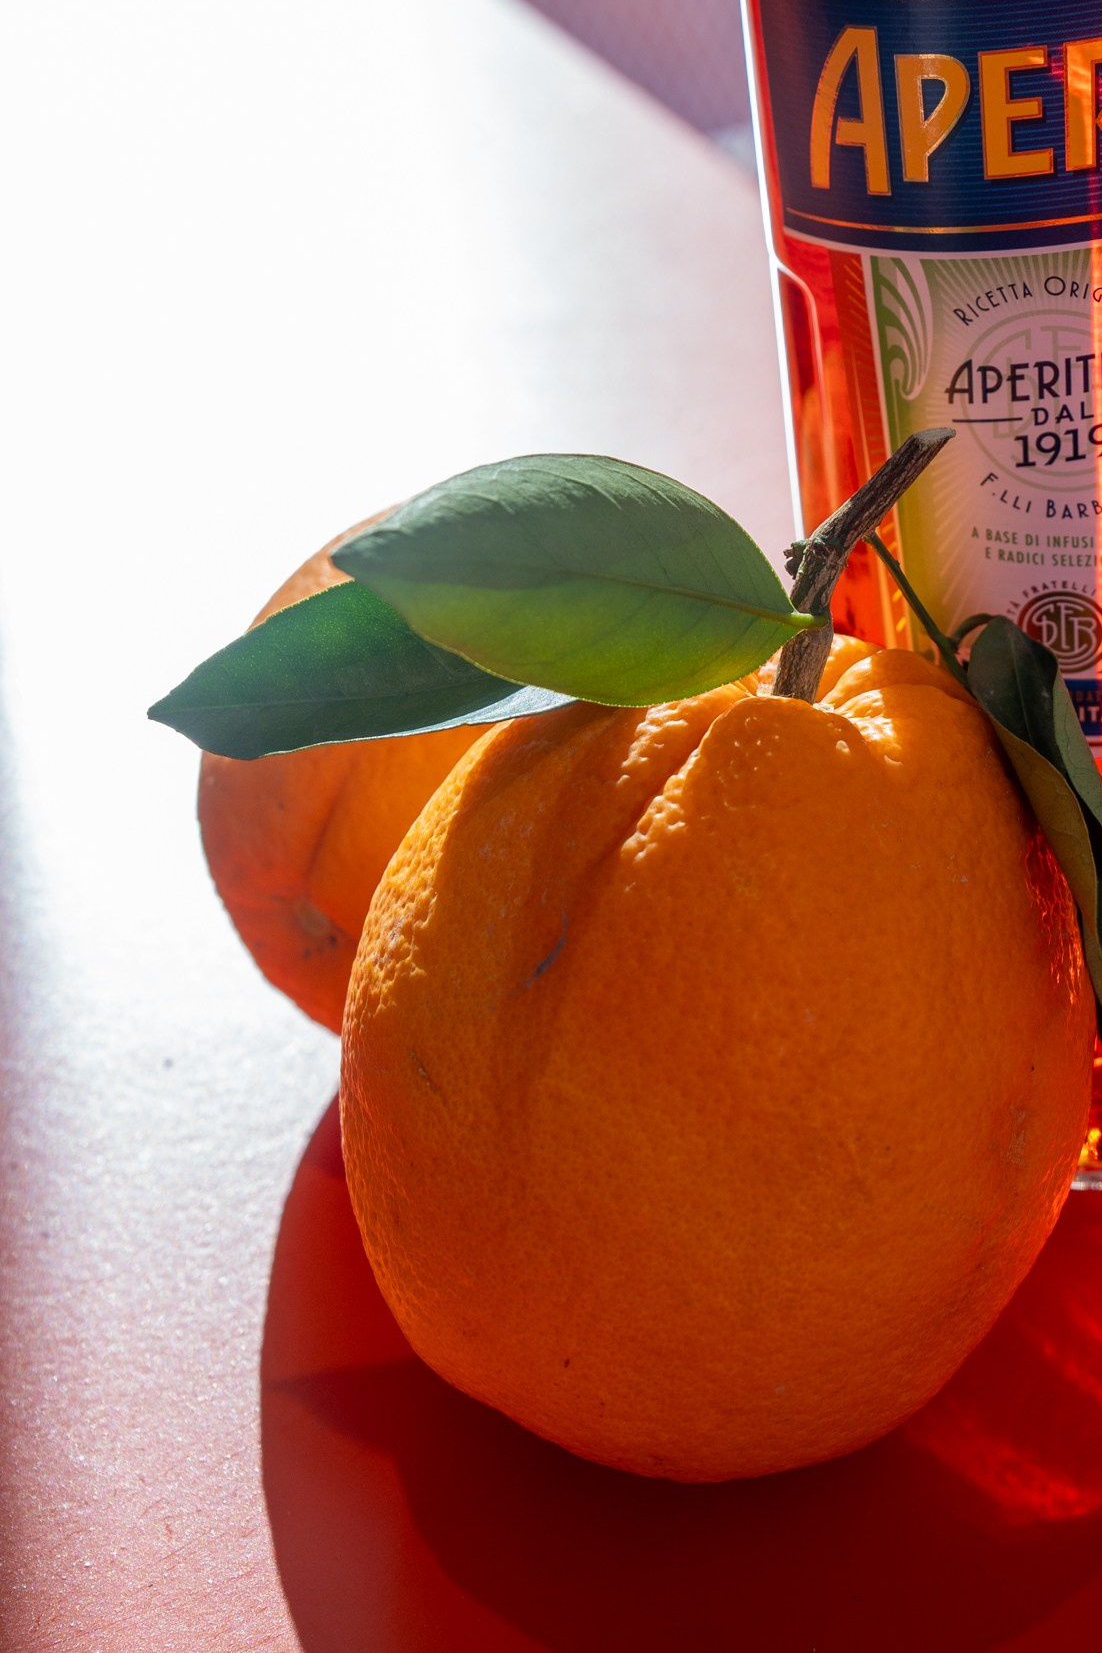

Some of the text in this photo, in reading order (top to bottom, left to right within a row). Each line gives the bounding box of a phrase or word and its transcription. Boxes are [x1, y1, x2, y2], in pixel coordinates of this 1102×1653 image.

[953, 282, 1033, 326] RICETTA
[1031, 401, 1094, 426] DAL
[980, 472, 1032, 513] F.LLI
[971, 526, 979, 539] A
[986, 528, 1018, 544] BASE
[1025, 533, 1039, 546] DI
[1047, 535, 1095, 548] INFUSI
[985, 547, 992, 559] E
[998, 549, 1045, 565] RADICI
[1022, 580, 1096, 598] FRATELLI
